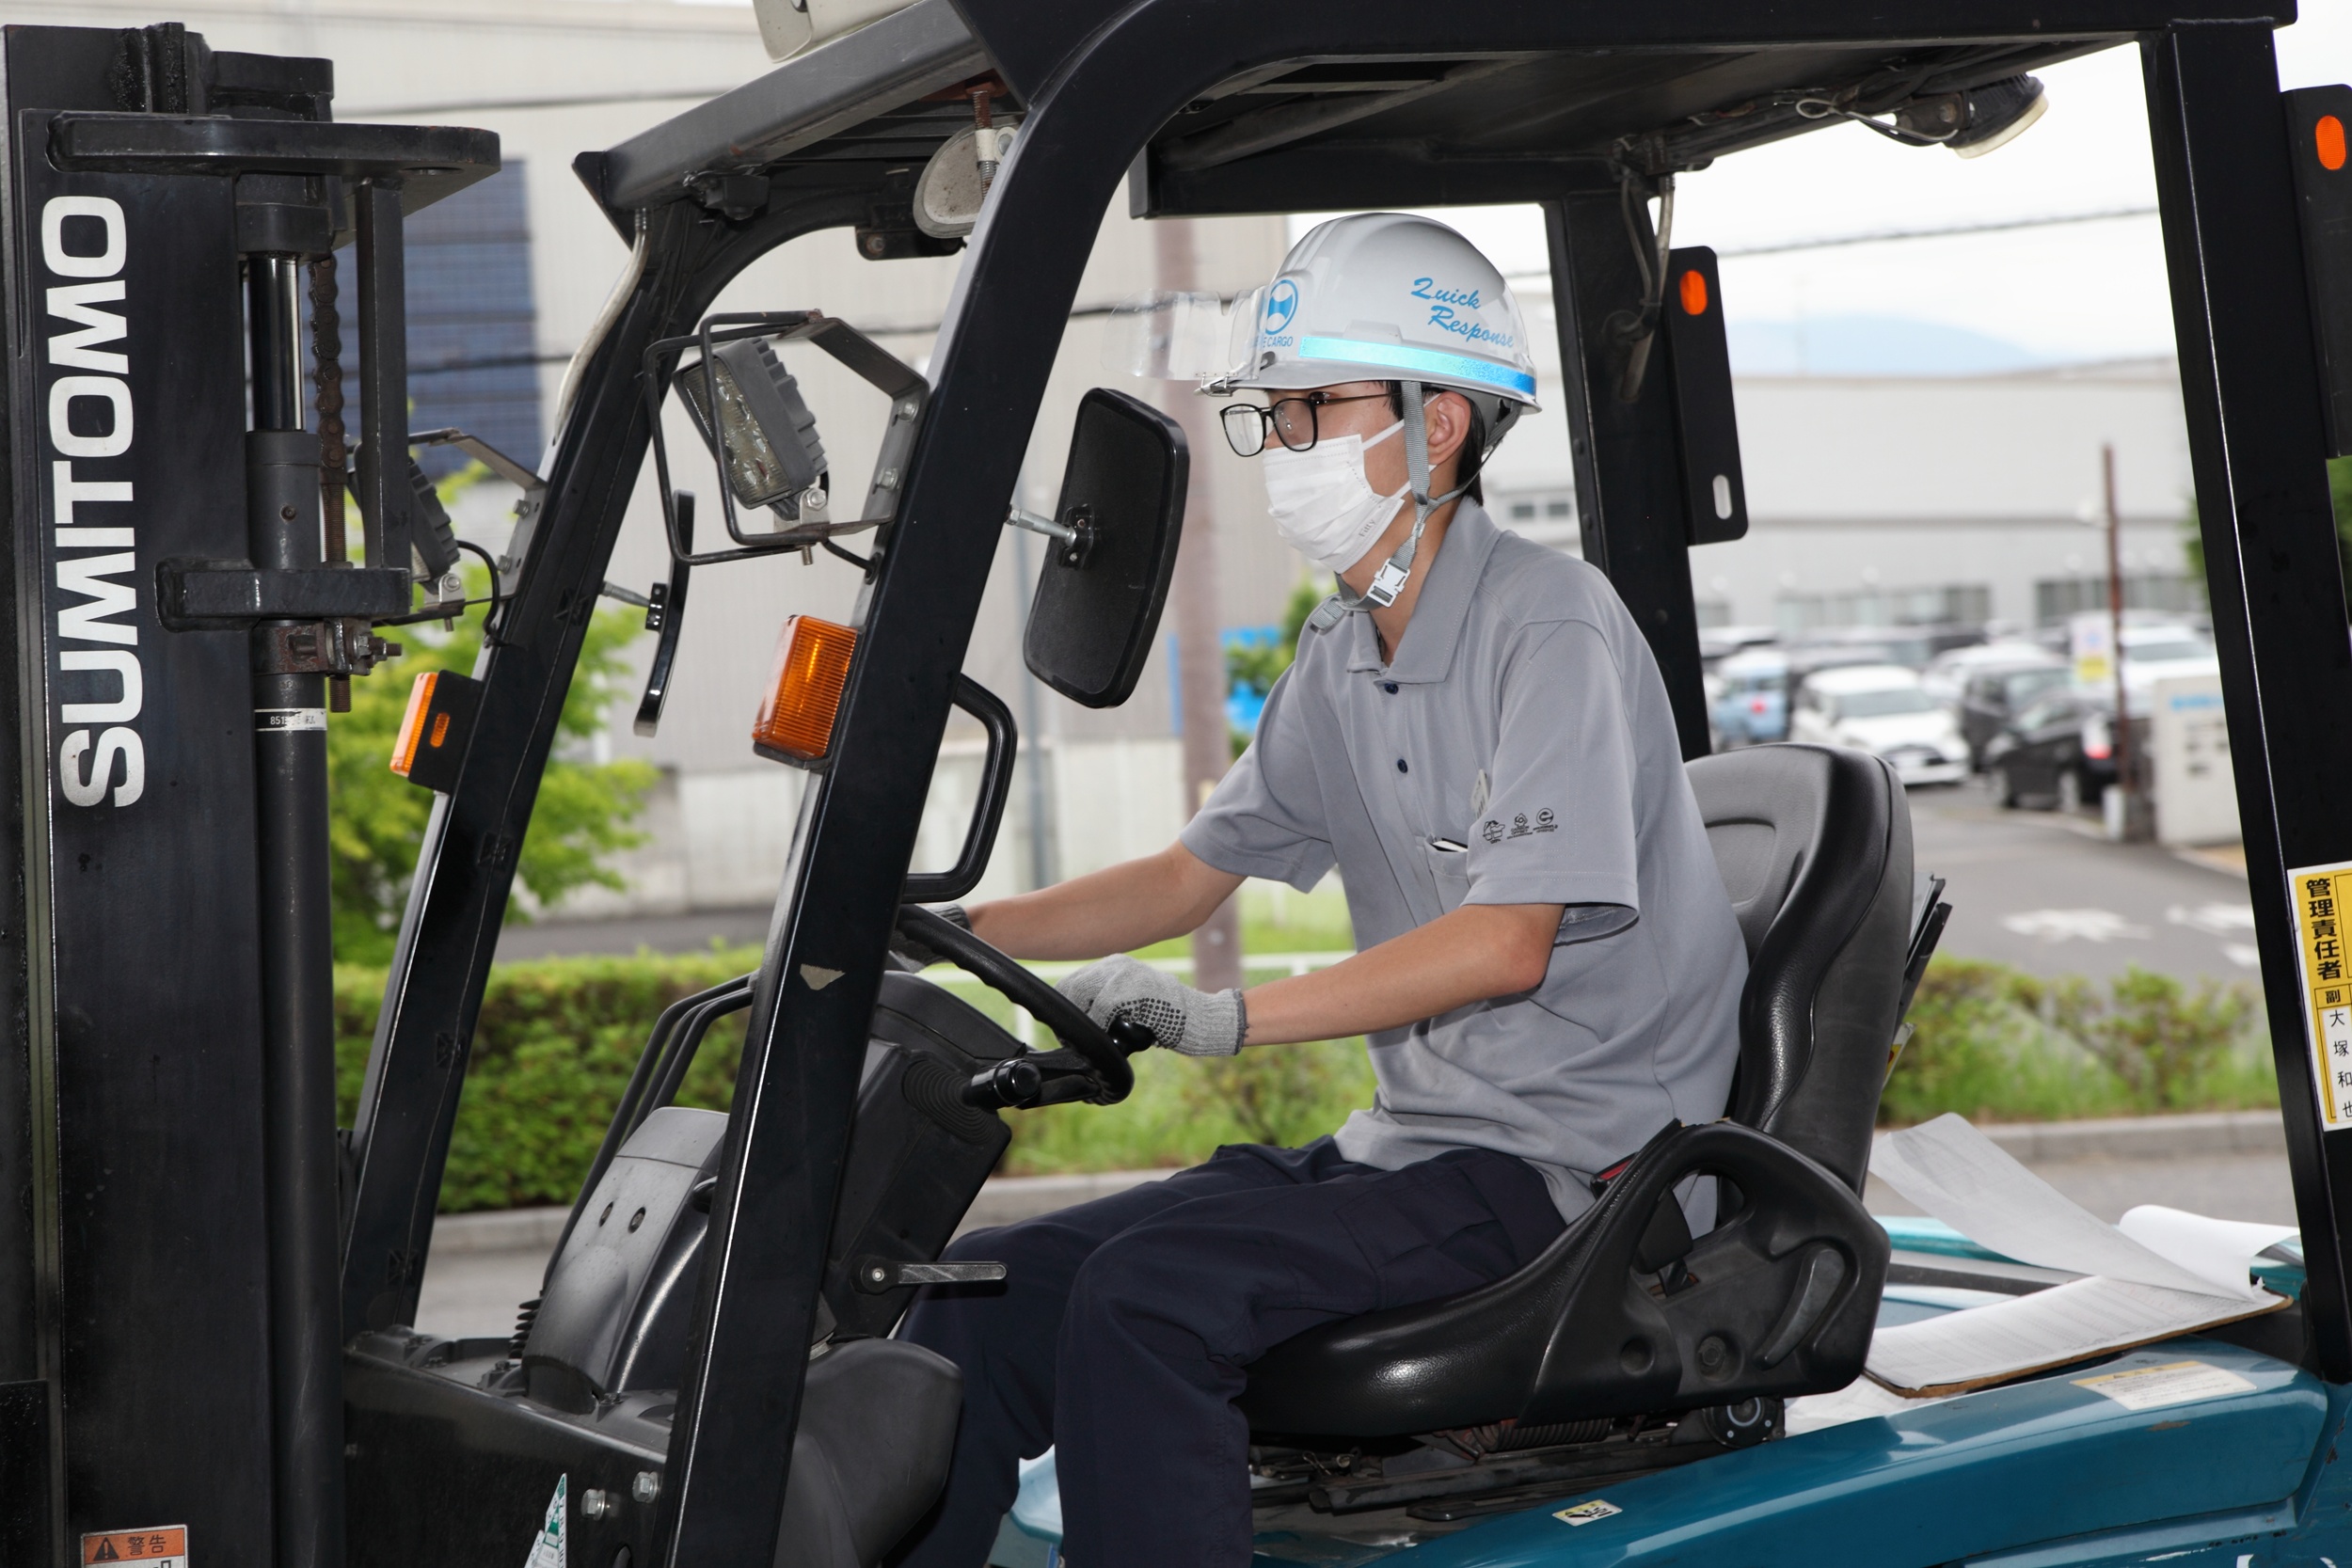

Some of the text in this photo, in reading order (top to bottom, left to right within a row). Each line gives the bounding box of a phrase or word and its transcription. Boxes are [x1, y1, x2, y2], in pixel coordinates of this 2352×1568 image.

[1410, 277, 1481, 309] Quick
[1267, 336, 1294, 347] CARGO
[1427, 305, 1515, 348] Response
[41, 195, 145, 807] SUMITOMO
[2306, 878, 2342, 980] 管理責任者
[2325, 990, 2341, 1004] 副
[128, 1534, 166, 1555] 警告
